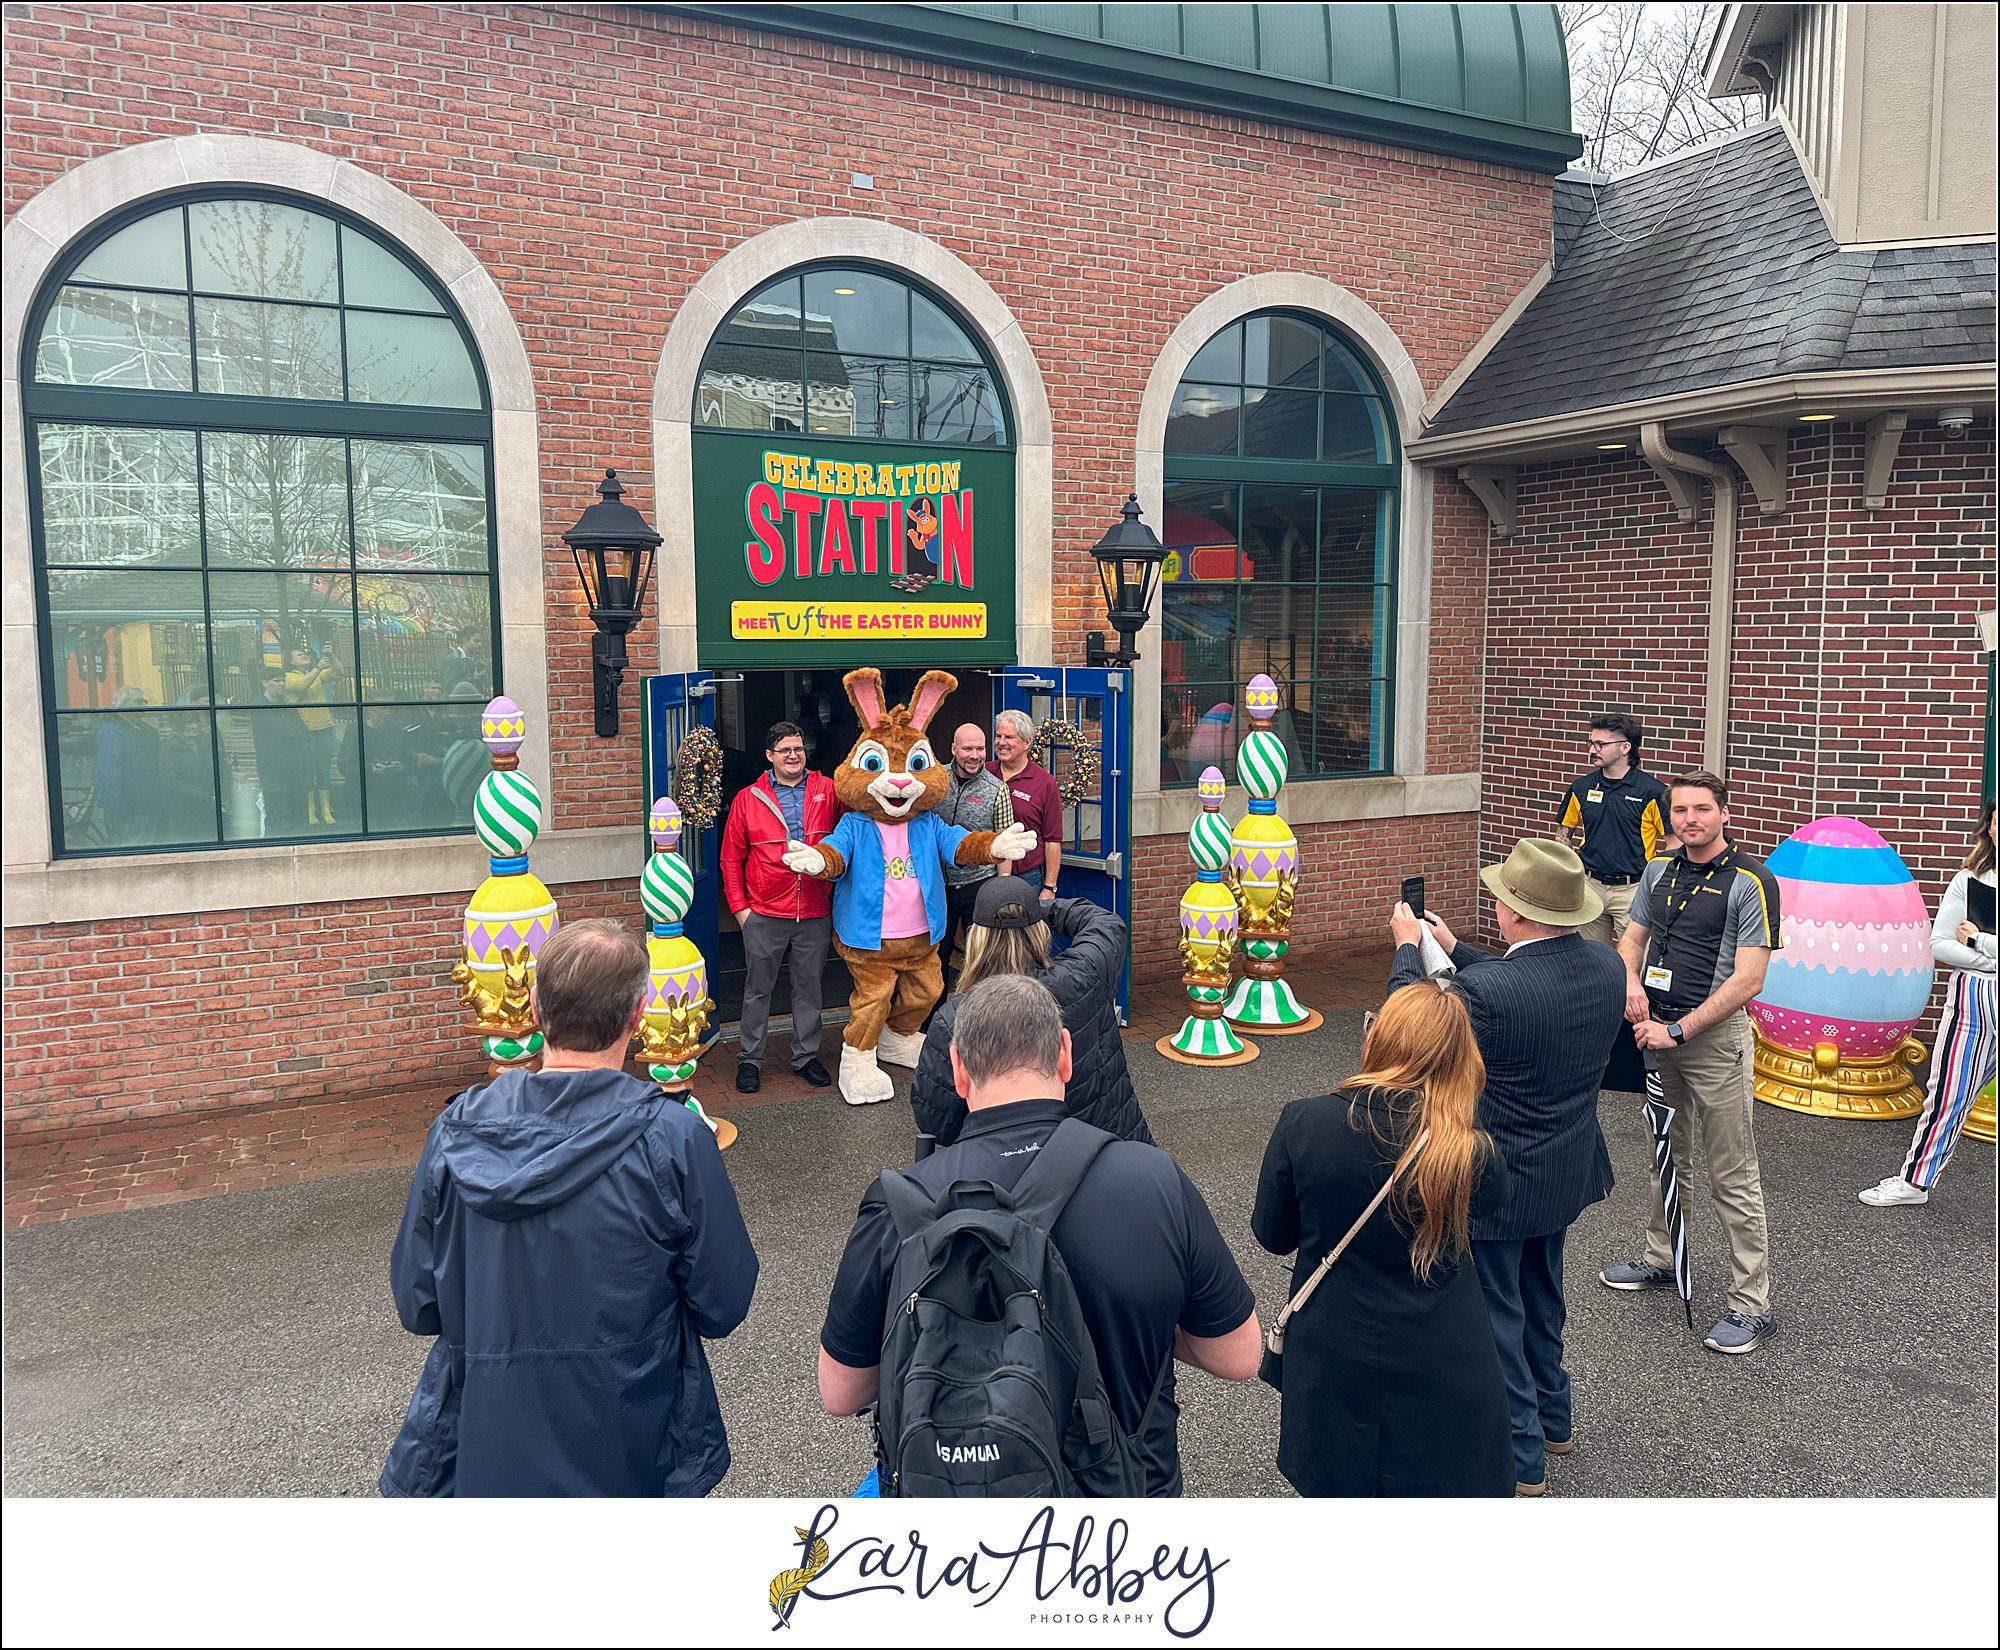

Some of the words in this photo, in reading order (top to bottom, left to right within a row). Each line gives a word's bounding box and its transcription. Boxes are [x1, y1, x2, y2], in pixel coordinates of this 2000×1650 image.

[764, 451, 961, 497] CELEBRATION
[739, 617, 774, 630] MEET
[823, 614, 851, 630] THE
[857, 614, 925, 630] EASTER
[929, 613, 983, 630] BUNNY
